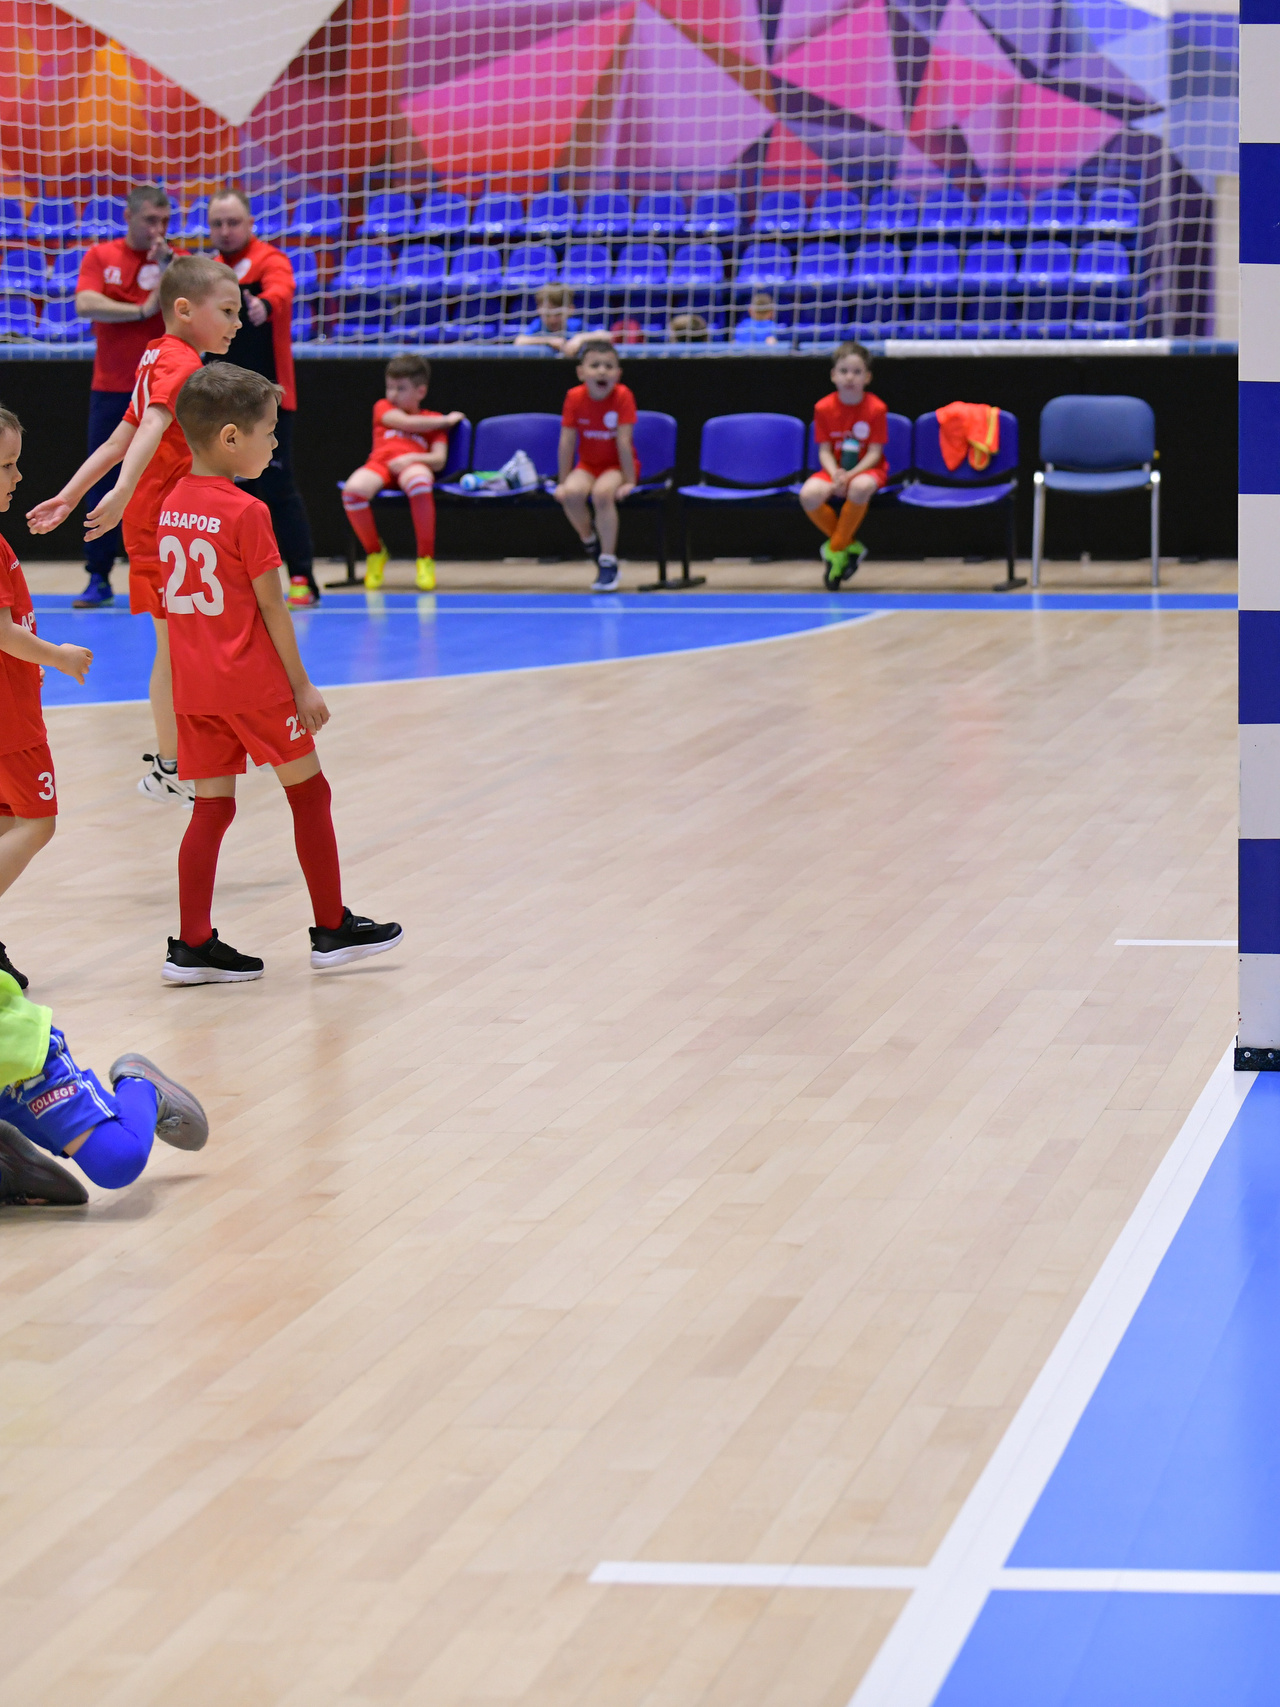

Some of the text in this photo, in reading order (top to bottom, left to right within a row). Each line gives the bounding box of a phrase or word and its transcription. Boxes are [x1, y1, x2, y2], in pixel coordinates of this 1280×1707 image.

[159, 535, 225, 616] 23
[38, 771, 54, 801] 3
[31, 1085, 75, 1113] COLLEGE
